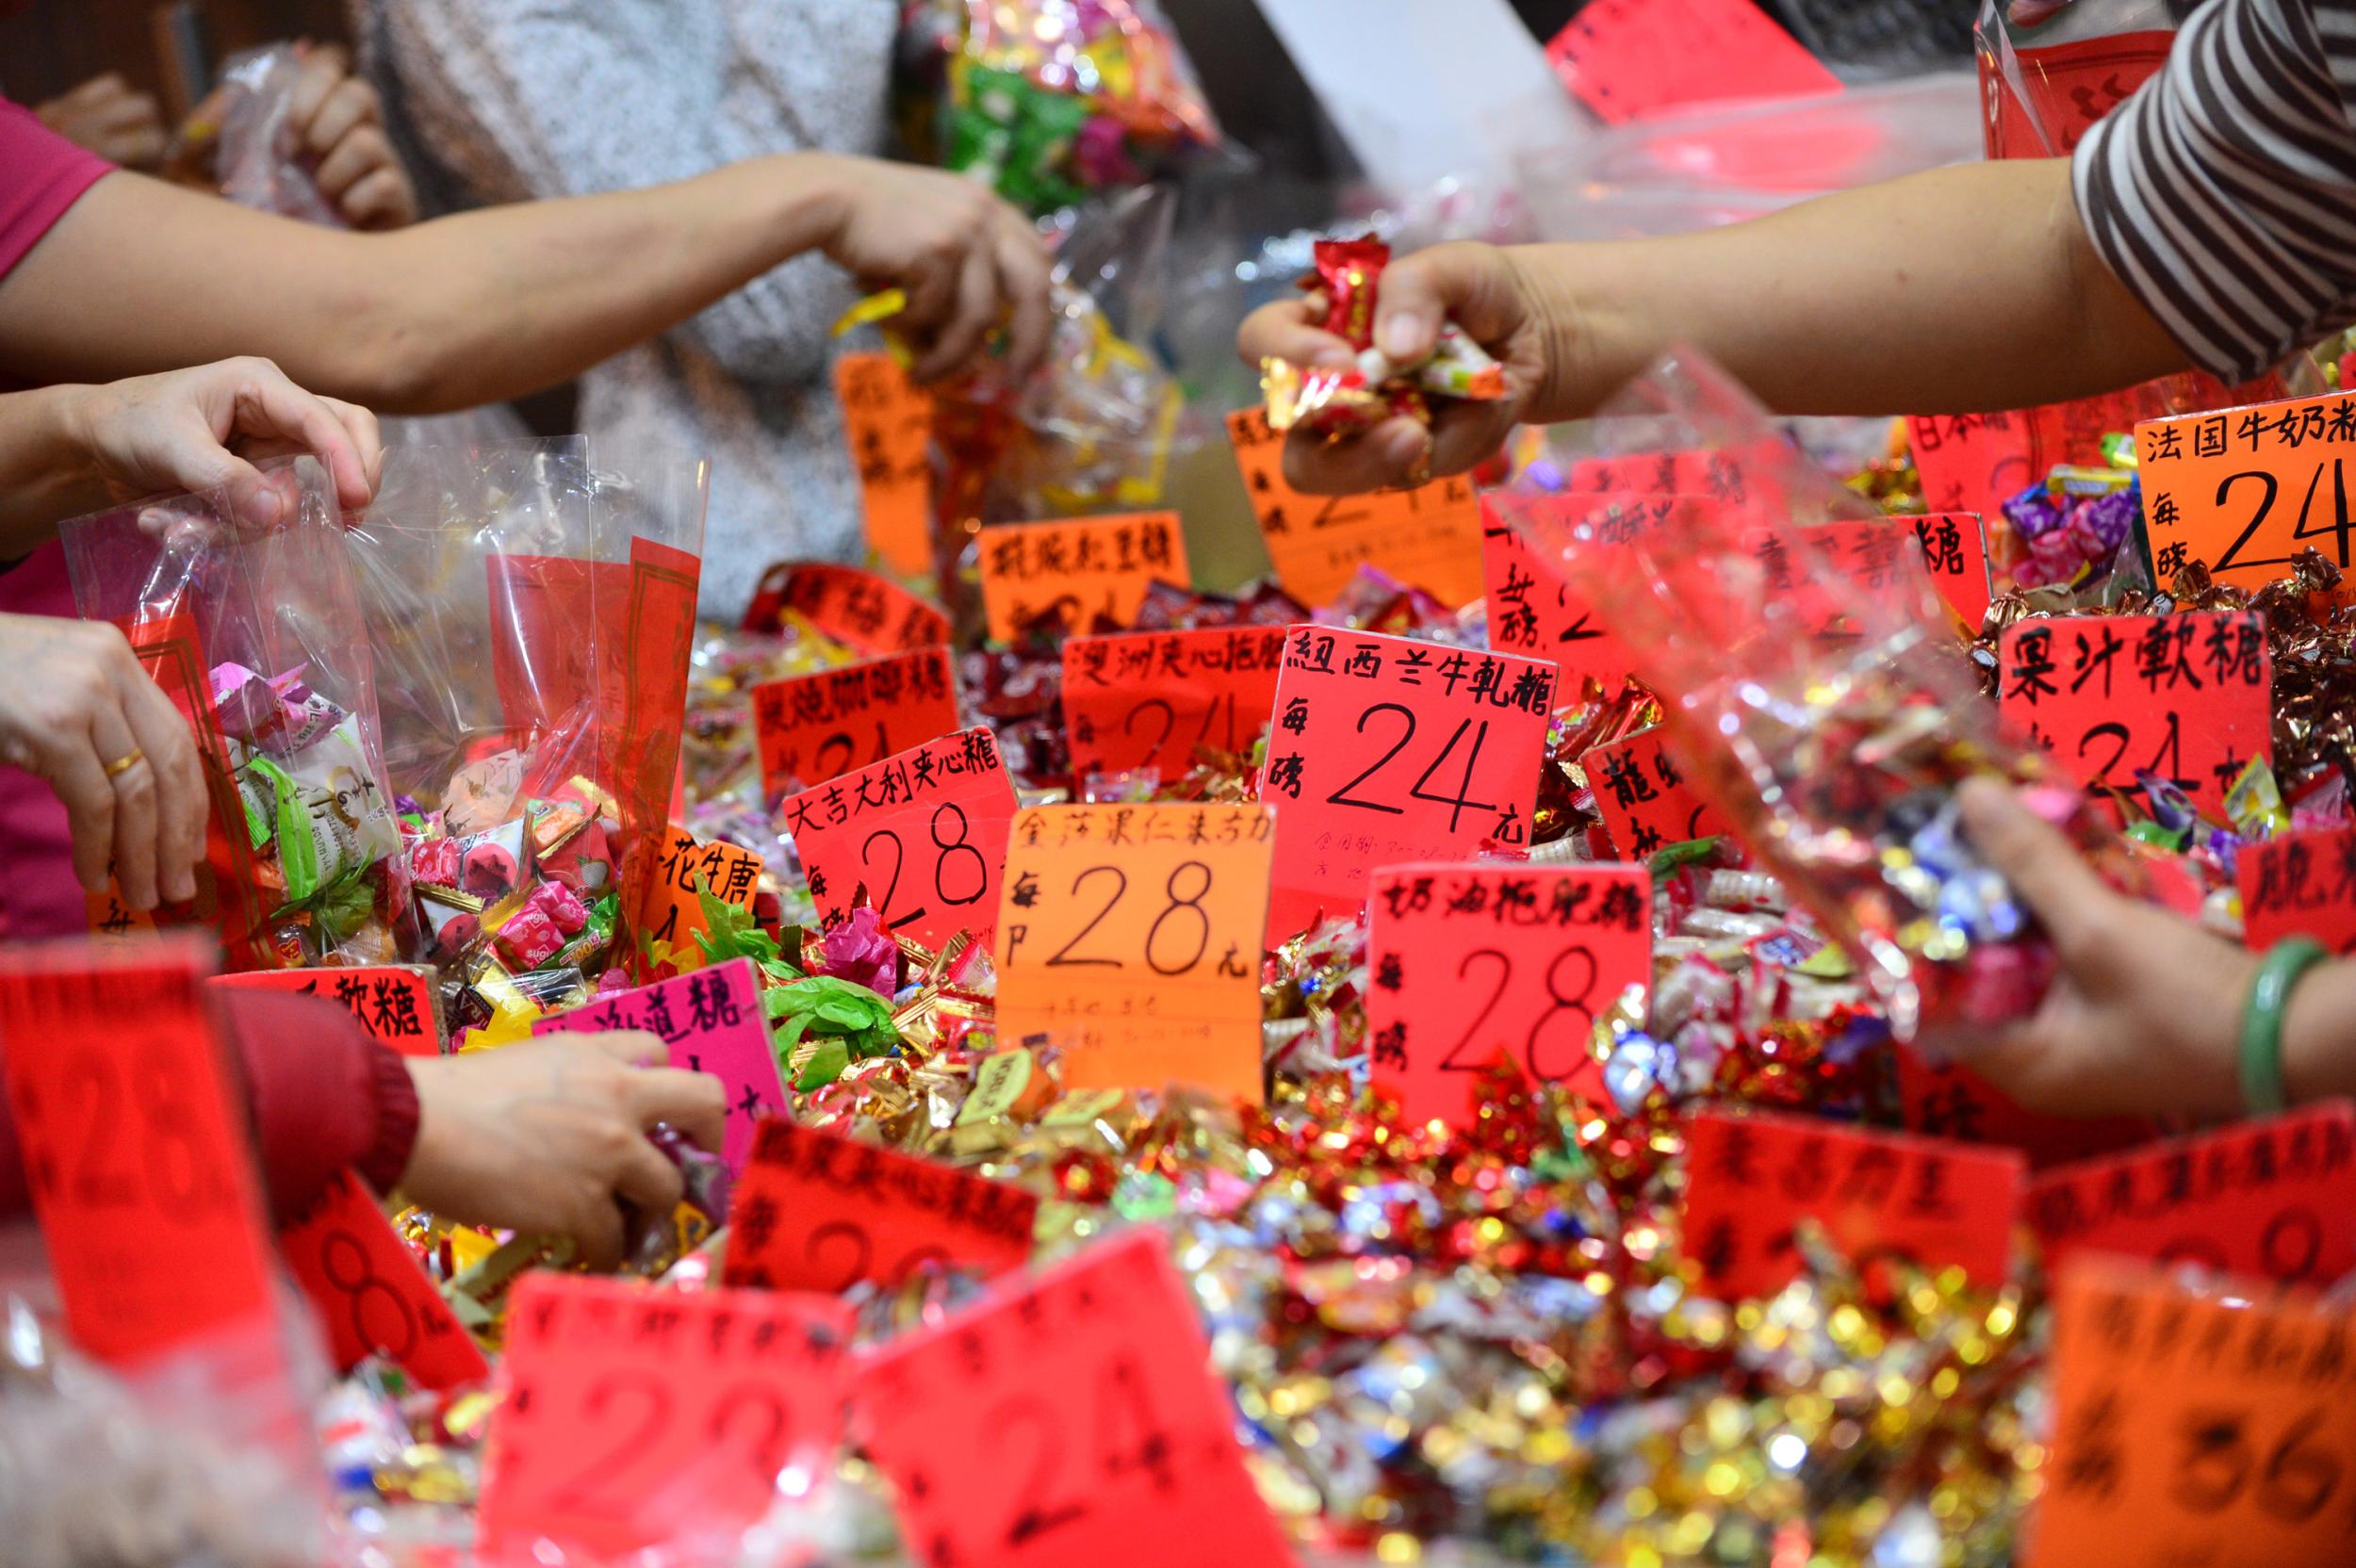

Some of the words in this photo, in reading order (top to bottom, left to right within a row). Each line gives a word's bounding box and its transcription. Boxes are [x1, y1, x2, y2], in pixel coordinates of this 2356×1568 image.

[2211, 459, 2356, 573] 24
[787, 733, 999, 841] 大吉大利夹心糖
[1268, 696, 1308, 799] 每磅
[1326, 702, 1497, 833] 24
[2078, 710, 2202, 797] 24
[861, 801, 988, 930] 28
[1491, 803, 1524, 844] 元
[525, 945, 555, 964] sugu
[1043, 859, 1213, 977] 28
[296, 973, 423, 1037] 軟糖
[1438, 945, 1598, 1085] 28
